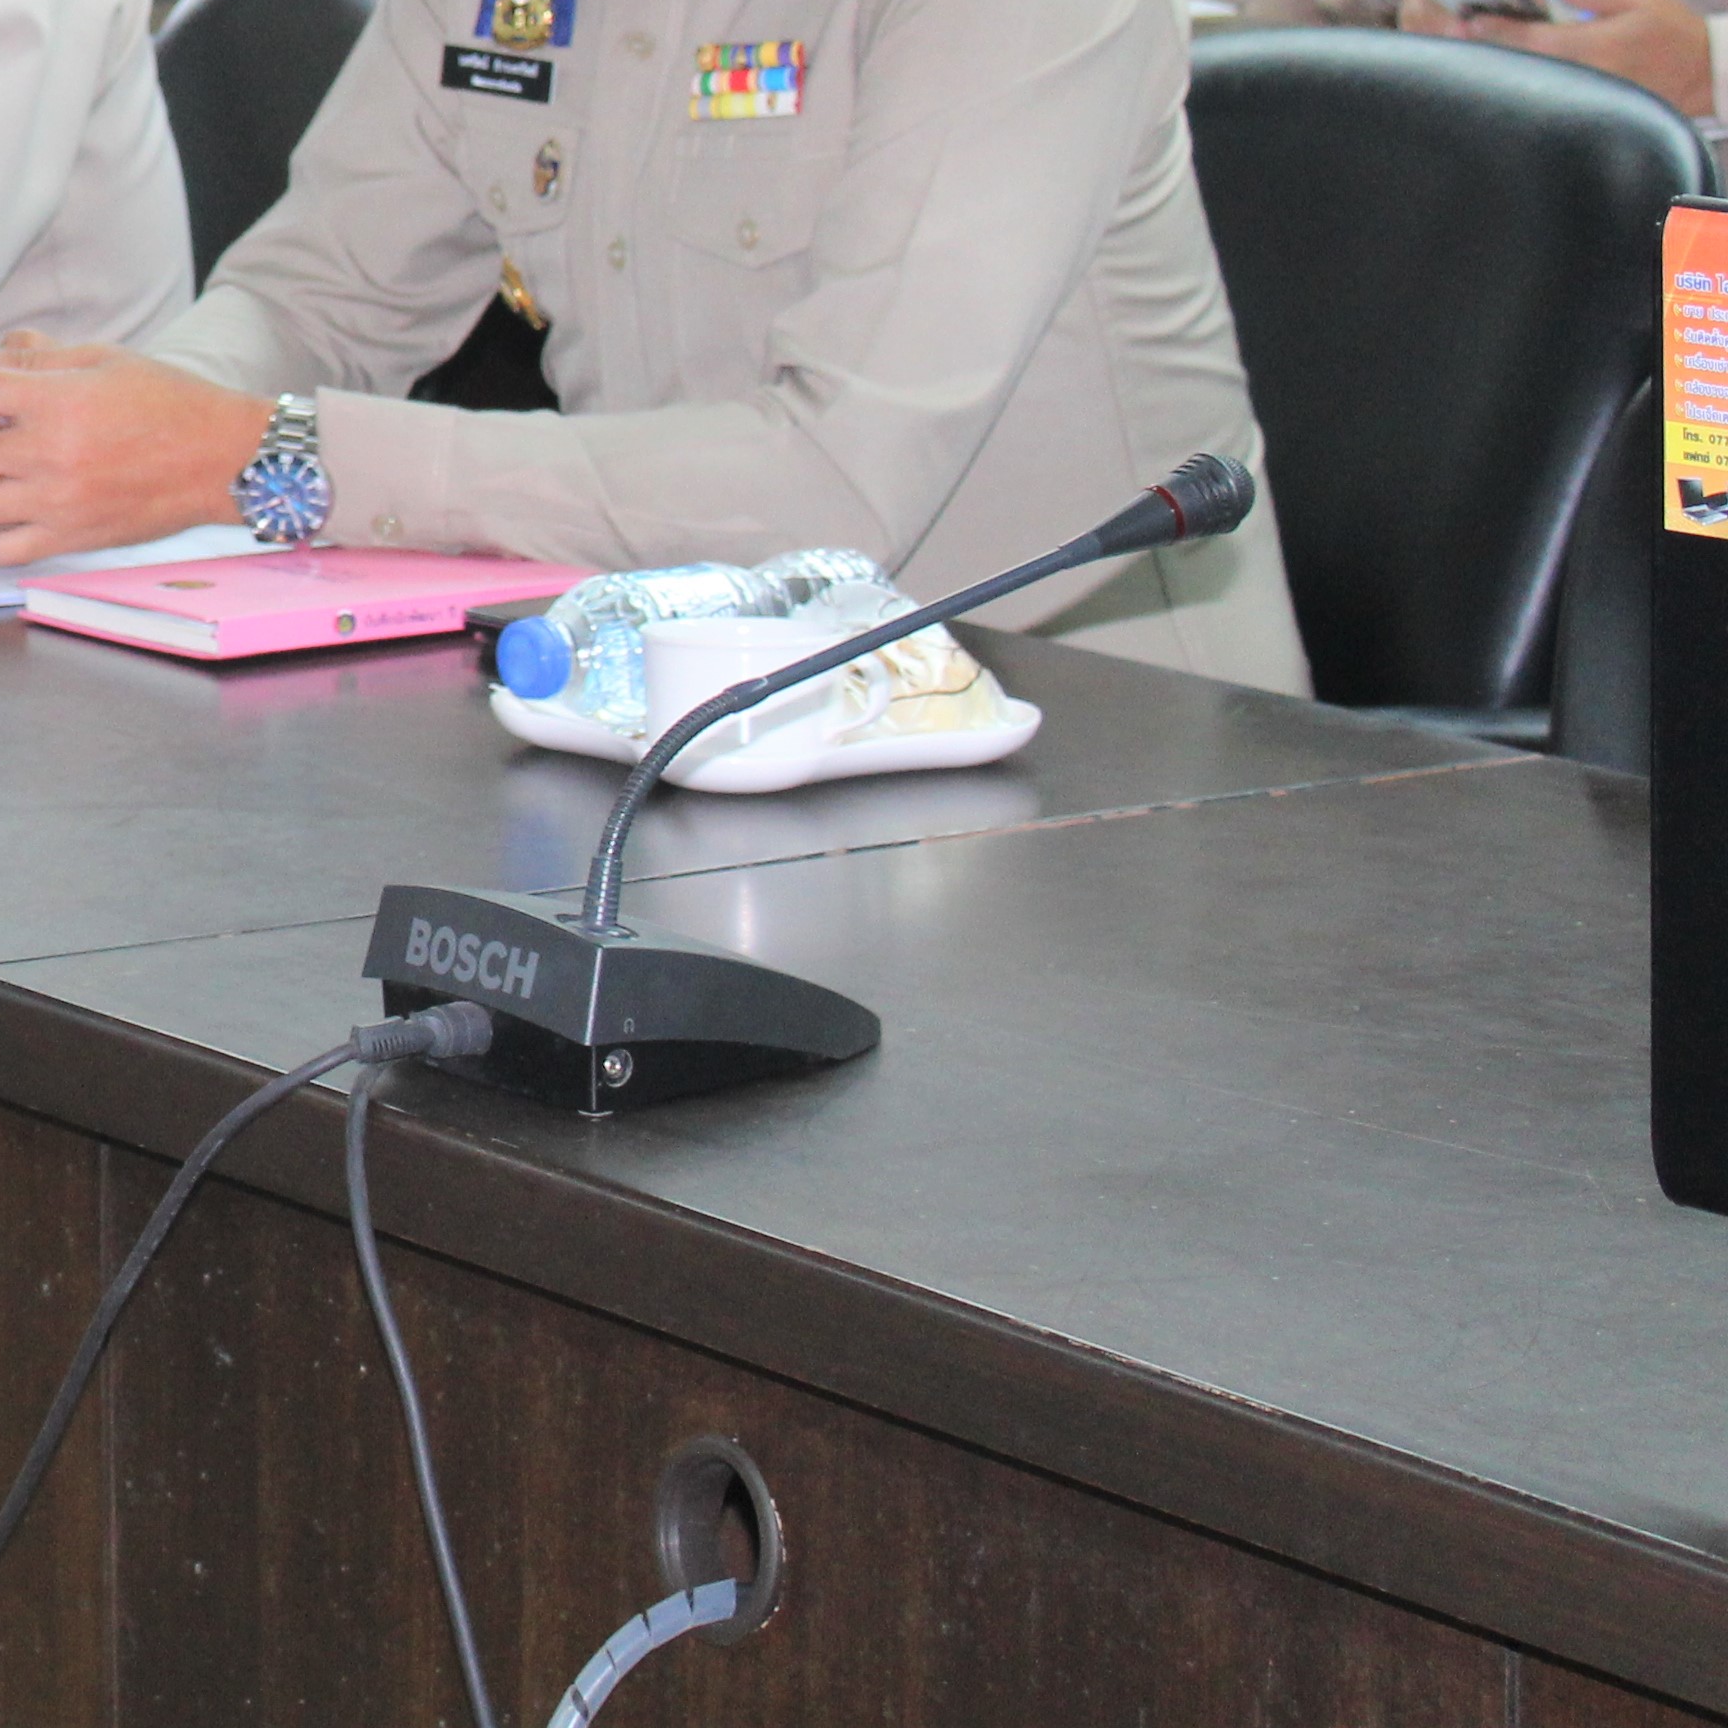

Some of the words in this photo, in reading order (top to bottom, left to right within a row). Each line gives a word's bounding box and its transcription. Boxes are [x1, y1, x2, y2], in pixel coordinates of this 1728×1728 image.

[1675, 272, 1712, 292] บริษัท
[405, 917, 540, 1000] BOSCH
